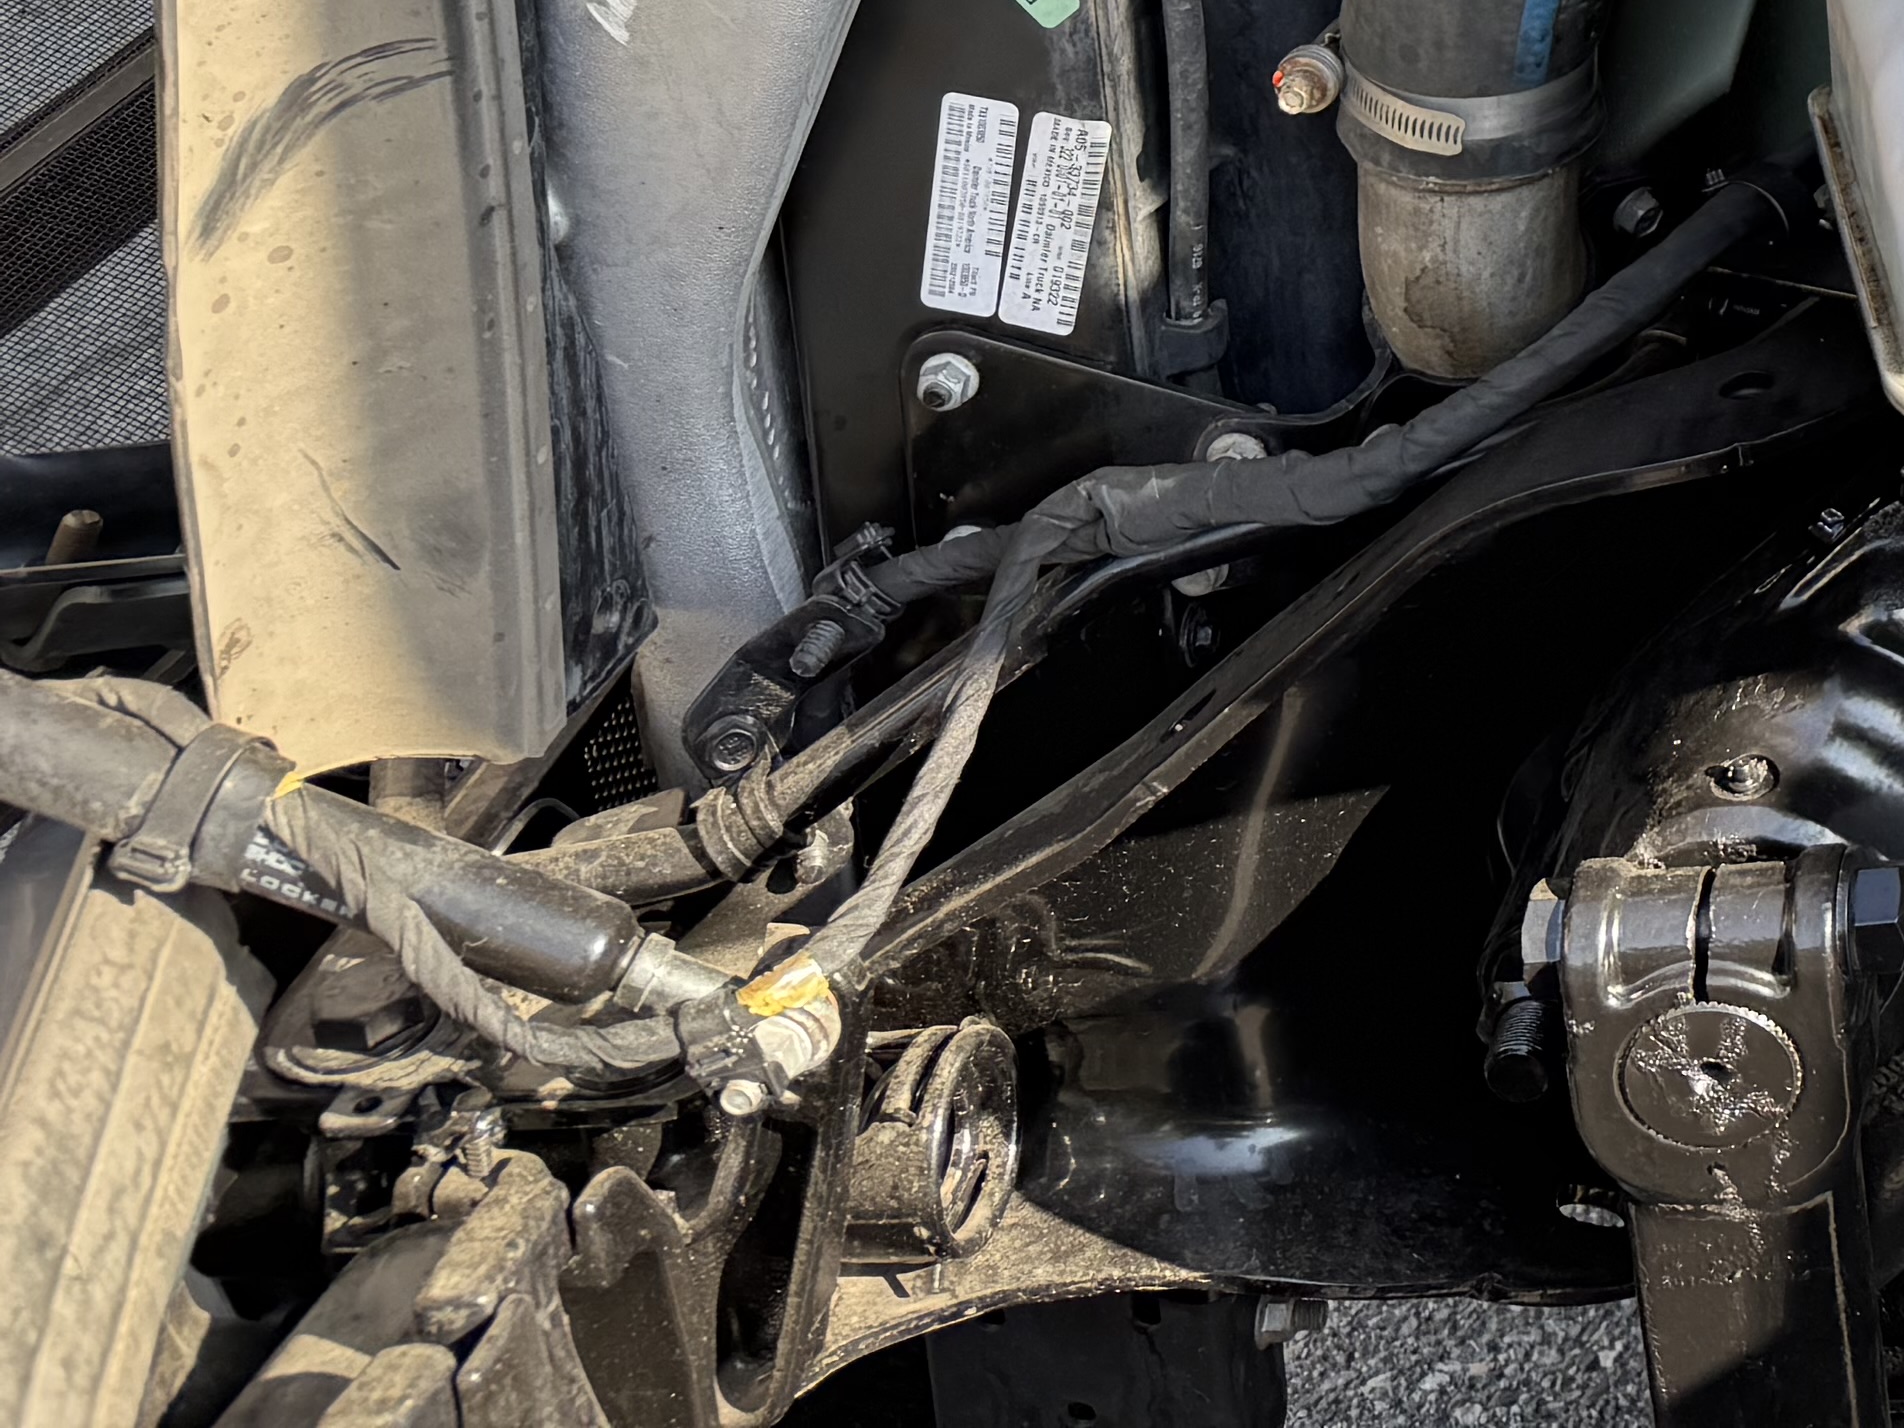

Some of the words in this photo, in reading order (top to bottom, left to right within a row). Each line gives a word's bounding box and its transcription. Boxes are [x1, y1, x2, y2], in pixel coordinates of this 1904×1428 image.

[1047, 143, 1057, 154] IN
[1041, 154, 1055, 189] MEXICO
[1038, 222, 1056, 264] Daimler
[1033, 265, 1048, 294] Truck
[1020, 291, 1032, 300] A
[1029, 296, 1042, 313] NA
